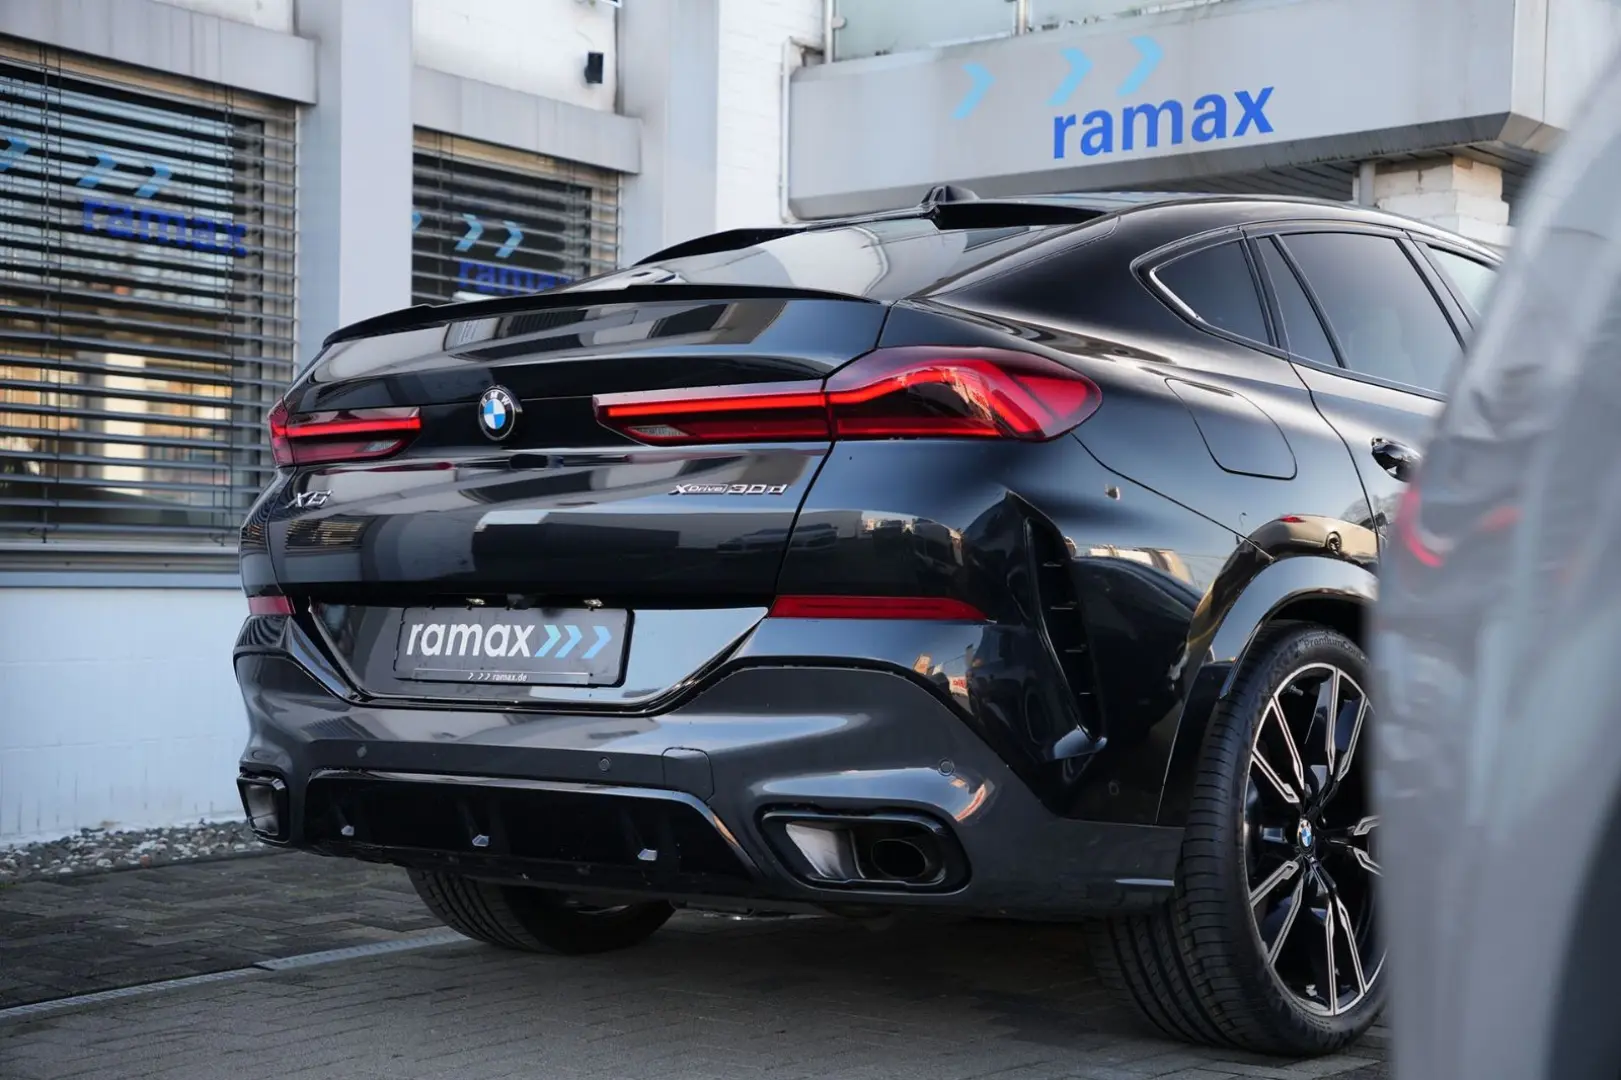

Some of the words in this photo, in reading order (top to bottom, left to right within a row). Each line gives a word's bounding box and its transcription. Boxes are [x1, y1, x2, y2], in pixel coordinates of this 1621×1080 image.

[1053, 86, 1274, 159] ramax
[83, 199, 248, 257] ramax
[285, 490, 332, 508] X6
[406, 623, 535, 657] ramax
[492, 672, 527, 682] ramax.de
